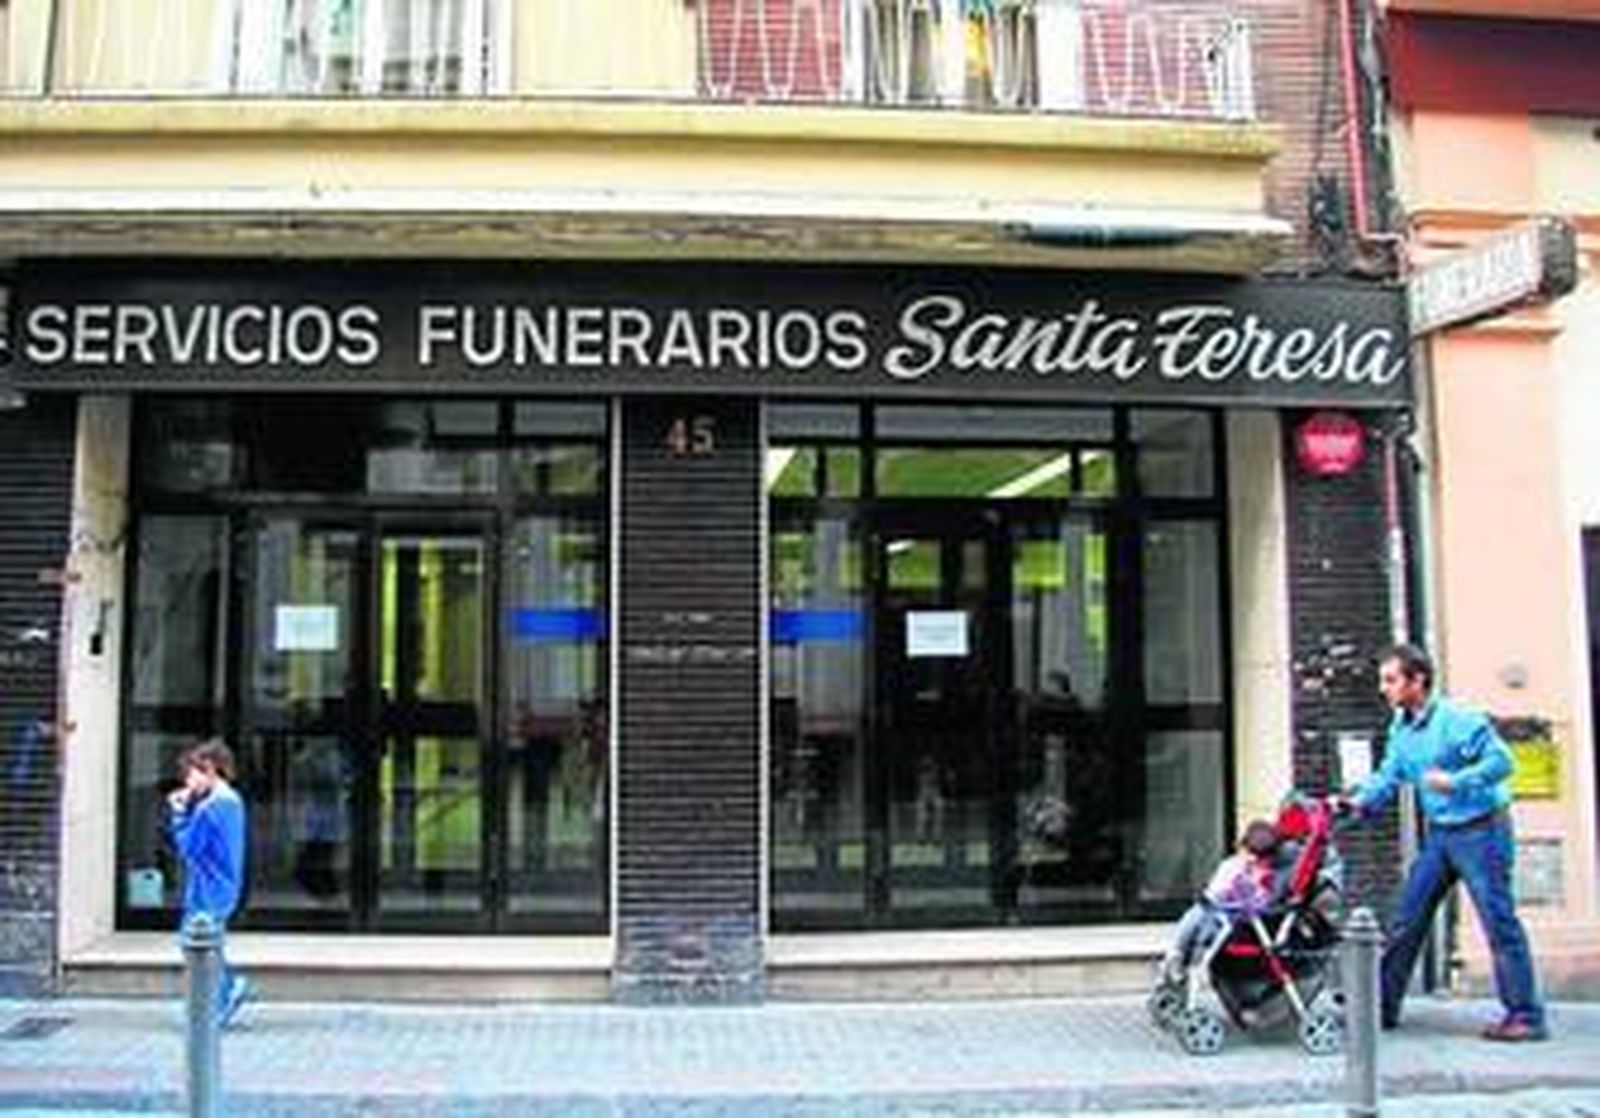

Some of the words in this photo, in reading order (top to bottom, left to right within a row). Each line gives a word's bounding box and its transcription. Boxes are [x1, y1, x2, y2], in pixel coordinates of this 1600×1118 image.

[26, 304, 380, 365] SERVICIOS
[418, 306, 868, 370] FUNERARIOS
[883, 296, 1147, 380] Santa
[1153, 305, 1406, 387] Teresa
[666, 416, 714, 455] 45
